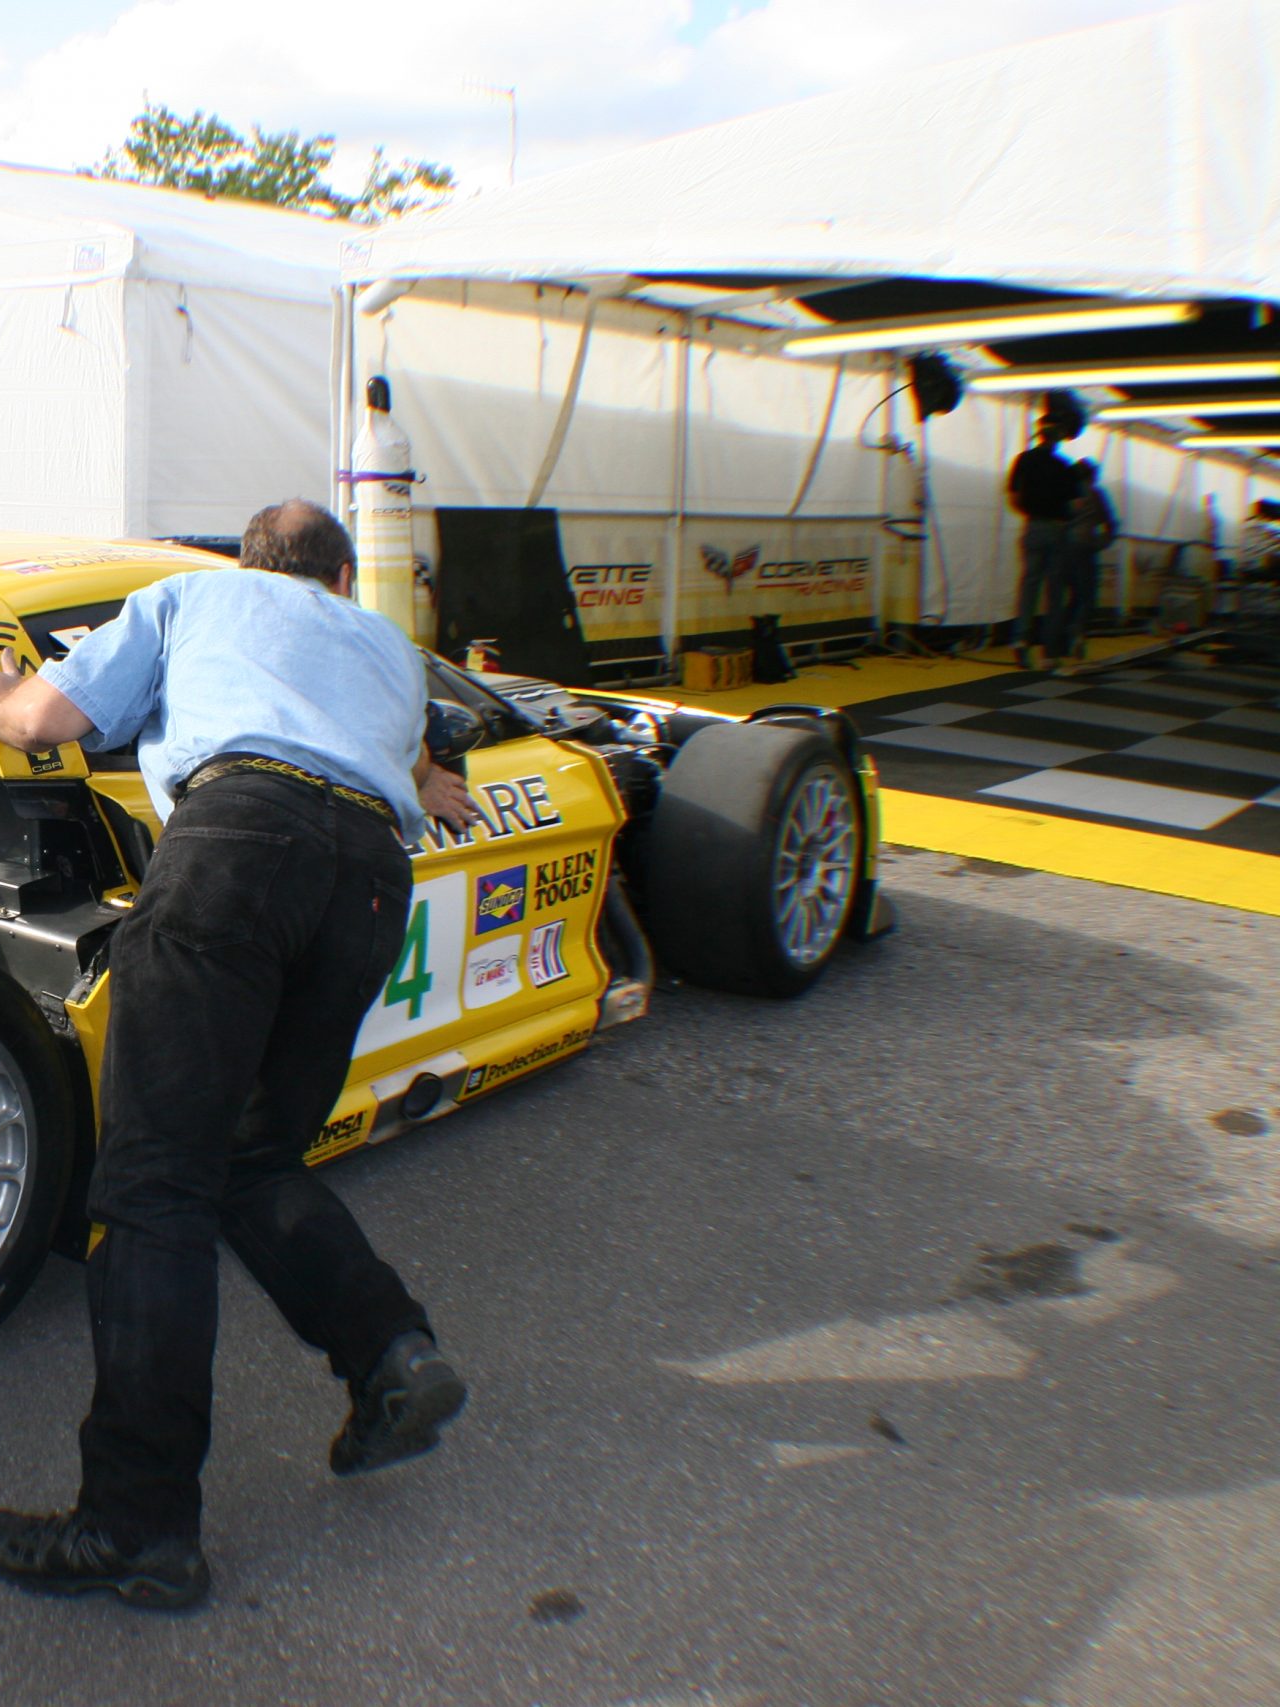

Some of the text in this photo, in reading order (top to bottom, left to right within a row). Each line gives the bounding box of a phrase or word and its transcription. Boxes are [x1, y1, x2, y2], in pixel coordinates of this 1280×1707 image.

[757, 558, 869, 579] CORVETTE
[577, 588, 646, 608] CING
[535, 850, 597, 888] KLEIN
[480, 887, 524, 916] SUNOCO
[534, 873, 594, 911] TOOLS
[383, 899, 433, 1021] 4
[486, 1042, 560, 1082] Protection
[560, 1028, 593, 1051] Plan
[312, 1110, 366, 1148] ORSA
